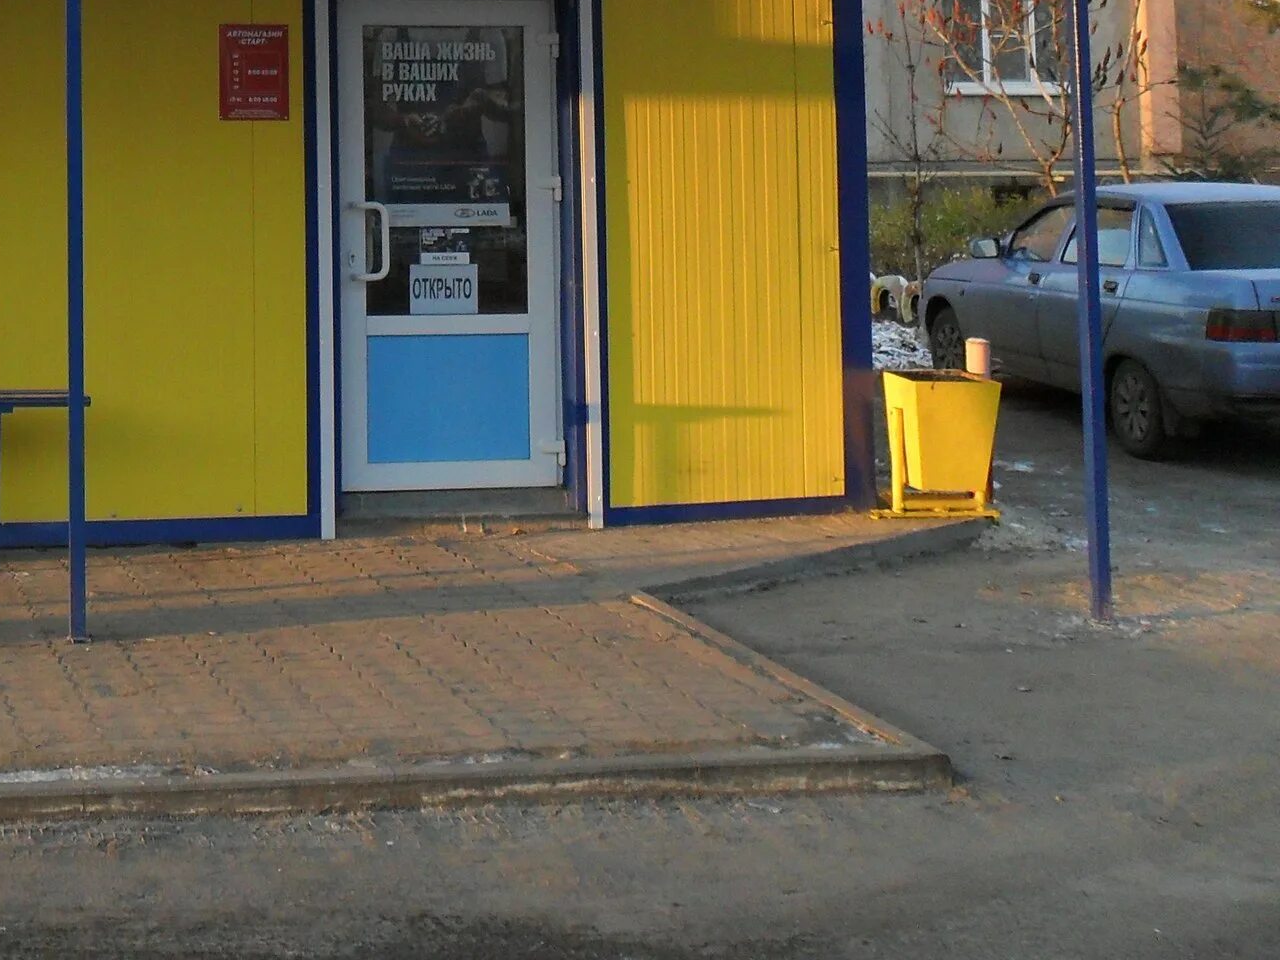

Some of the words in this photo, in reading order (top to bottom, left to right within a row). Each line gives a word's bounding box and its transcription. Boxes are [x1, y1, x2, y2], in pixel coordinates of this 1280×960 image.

[381, 42, 431, 60] ВАША
[437, 42, 496, 61] ЖИЗНЬ
[381, 63, 394, 81] В
[399, 63, 459, 81] ВАШИХ
[381, 83, 437, 102] РУКАХ
[476, 209, 499, 217] LADA
[412, 277, 472, 300] ОТКРЫТО
